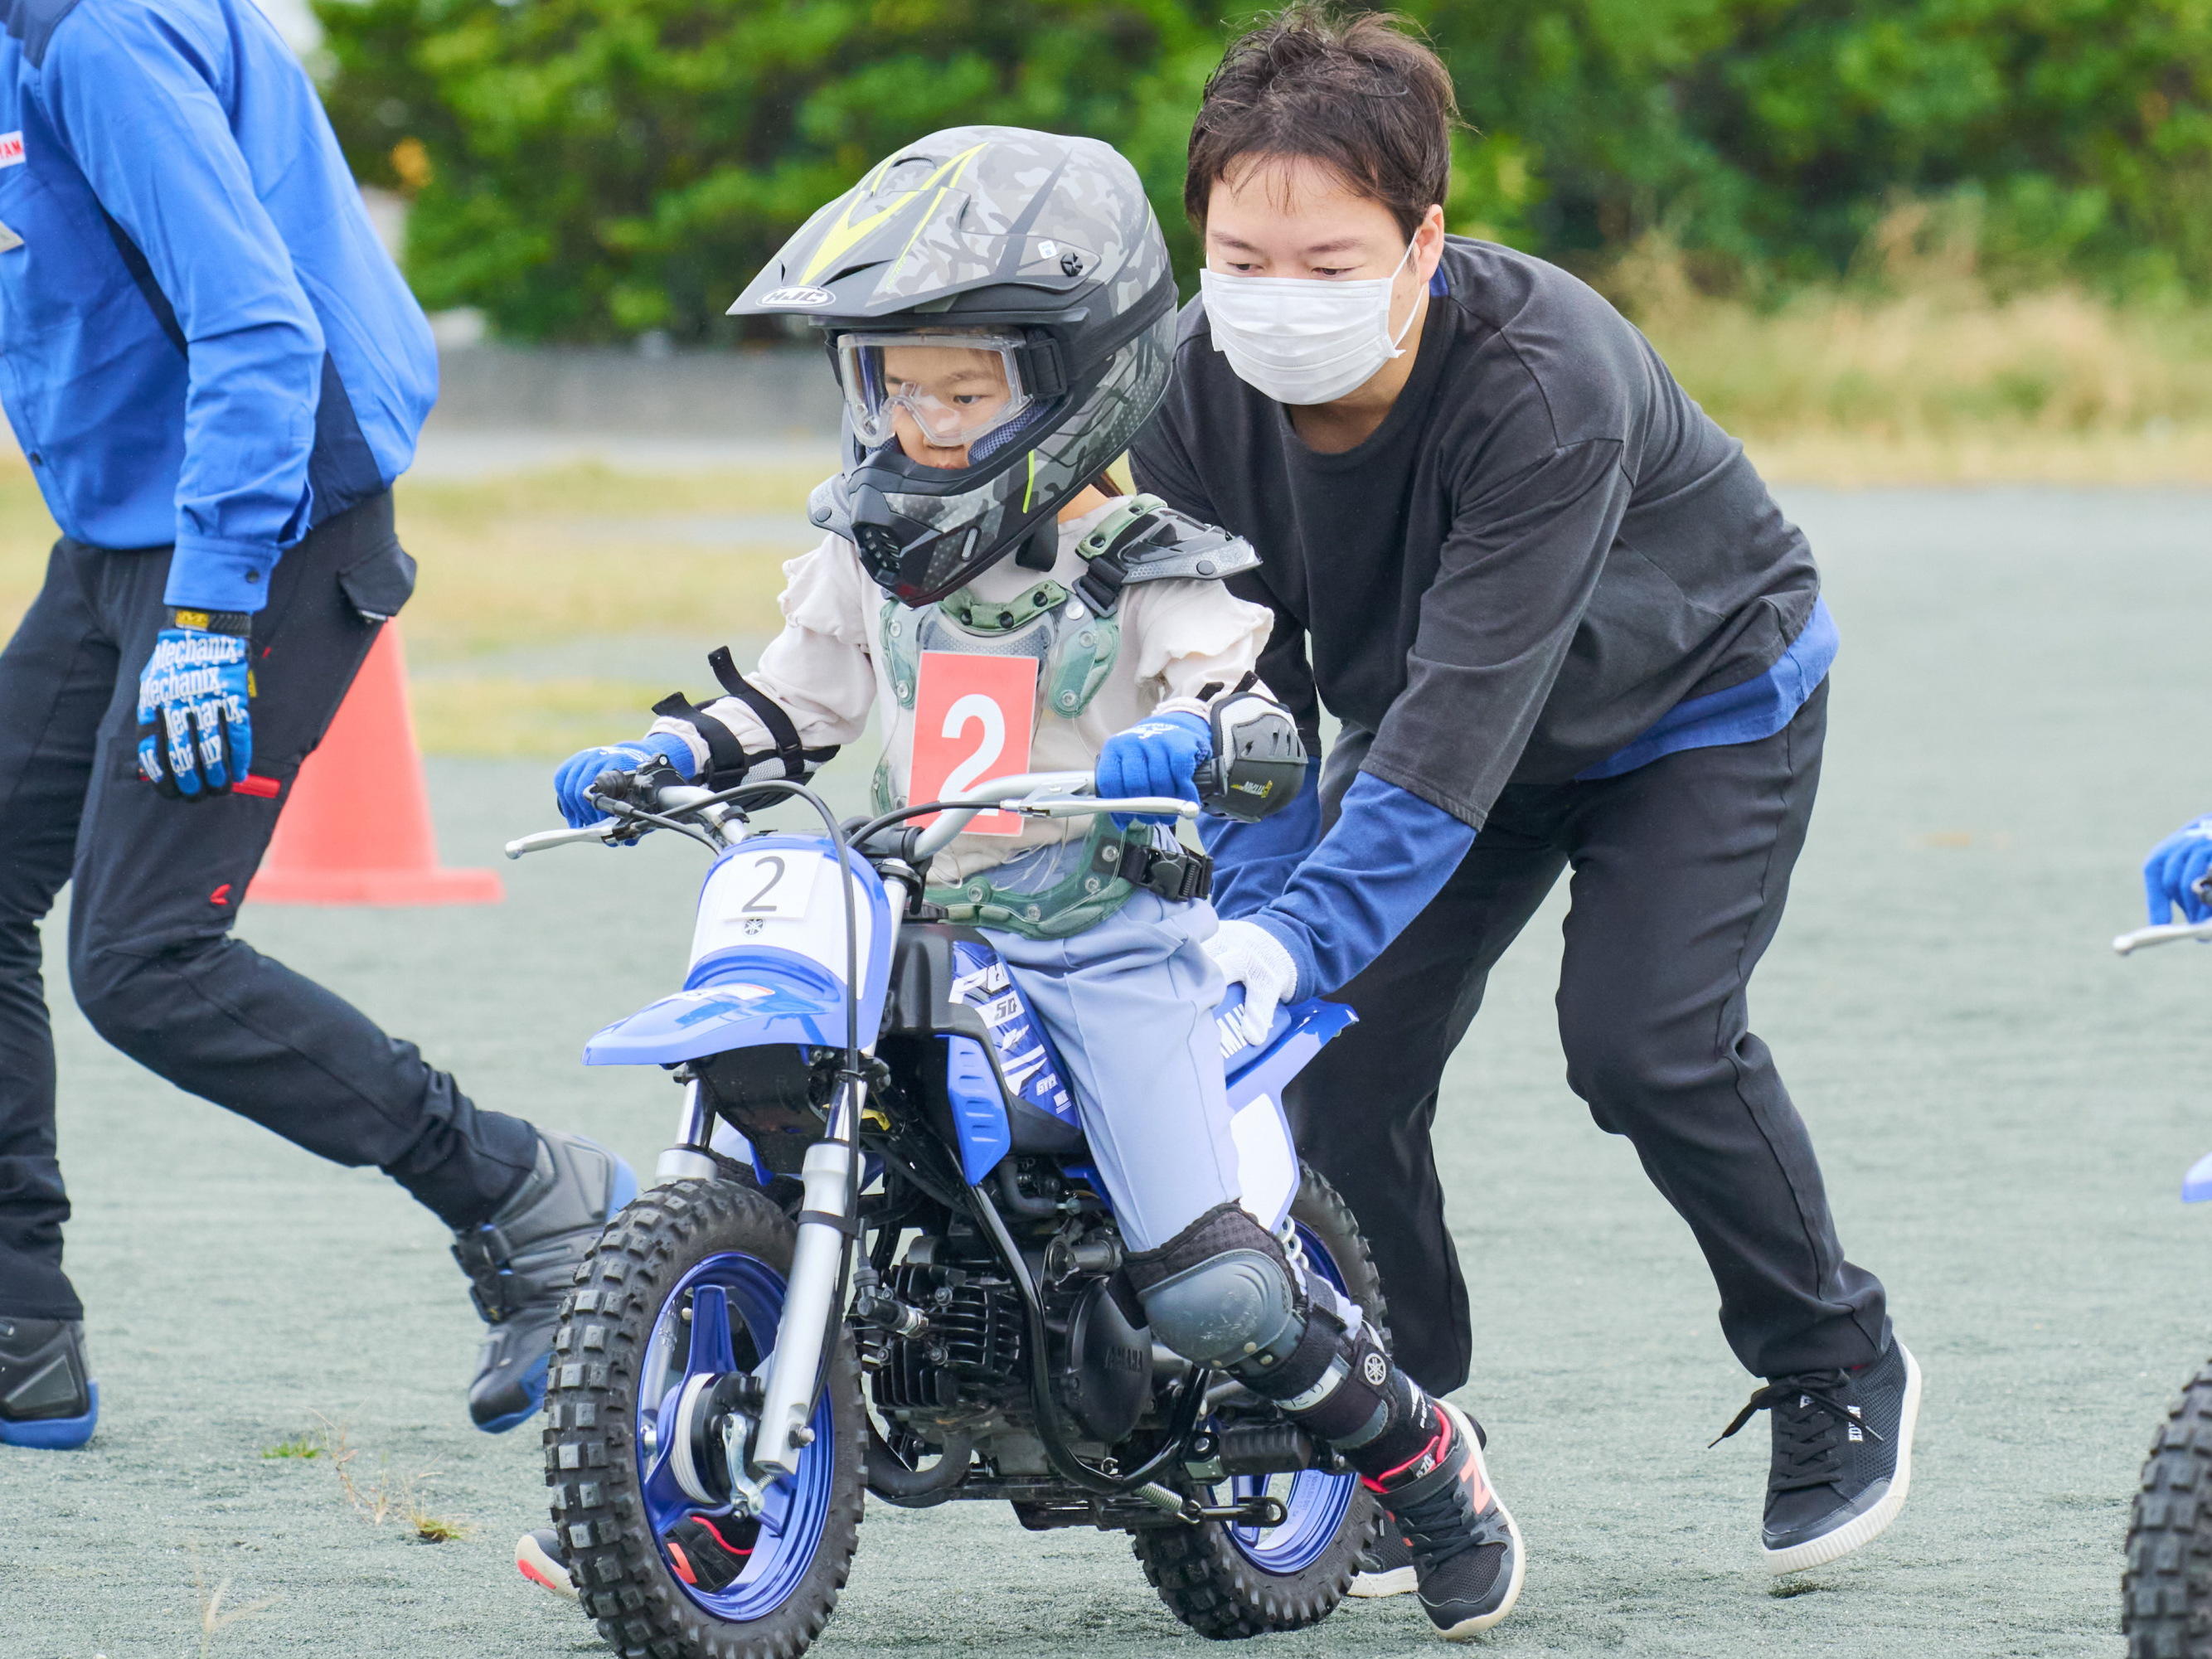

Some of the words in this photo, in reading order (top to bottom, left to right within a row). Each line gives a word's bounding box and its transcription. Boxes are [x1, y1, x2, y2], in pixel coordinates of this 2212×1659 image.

[764, 291, 824, 303] HJC
[939, 694, 1005, 816] 2
[741, 856, 785, 913] 2
[995, 997, 1017, 1021] 50
